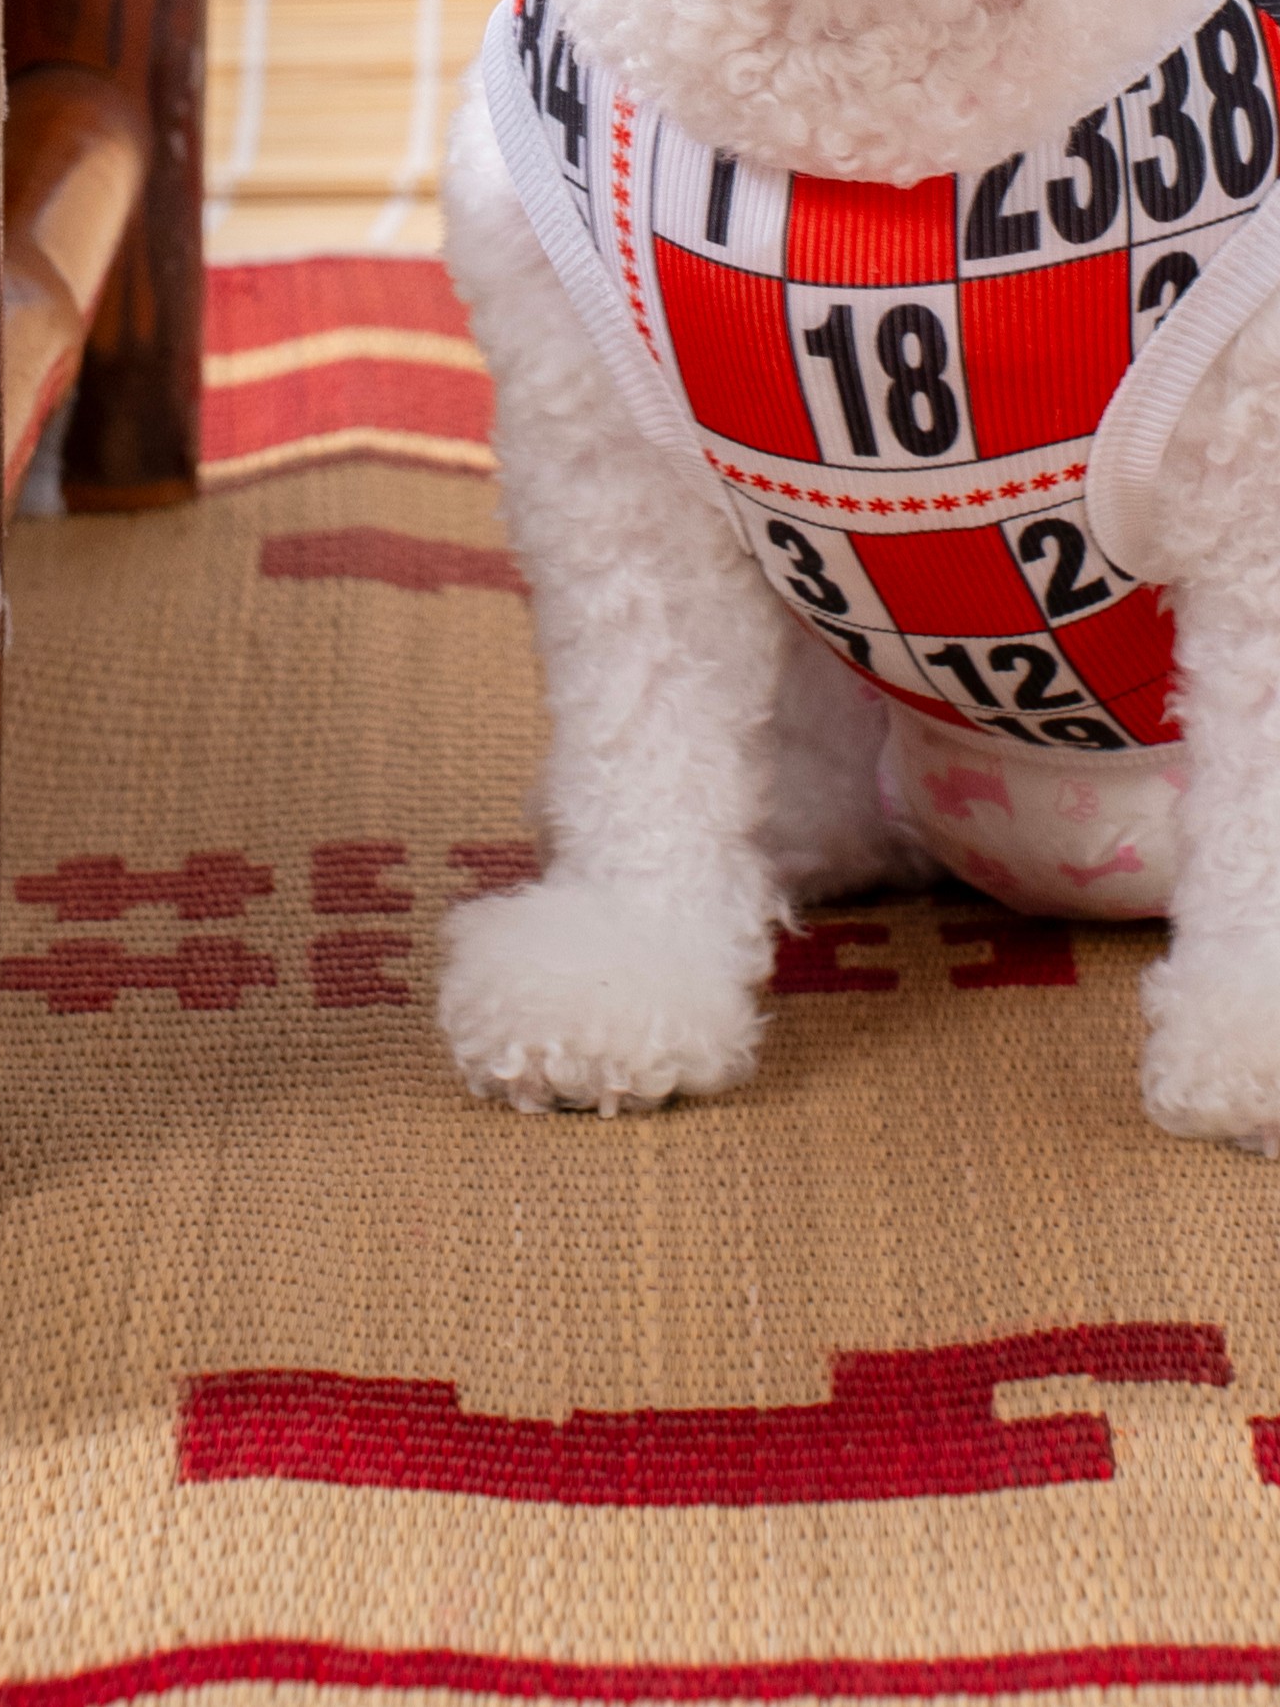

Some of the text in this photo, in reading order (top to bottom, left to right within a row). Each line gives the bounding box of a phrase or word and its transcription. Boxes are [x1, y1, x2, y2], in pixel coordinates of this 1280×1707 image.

[803, 302, 960, 459] 18
[767, 518, 850, 616] 3
[1019, 516, 1136, 620] 2
[924, 641, 1086, 711] 12
